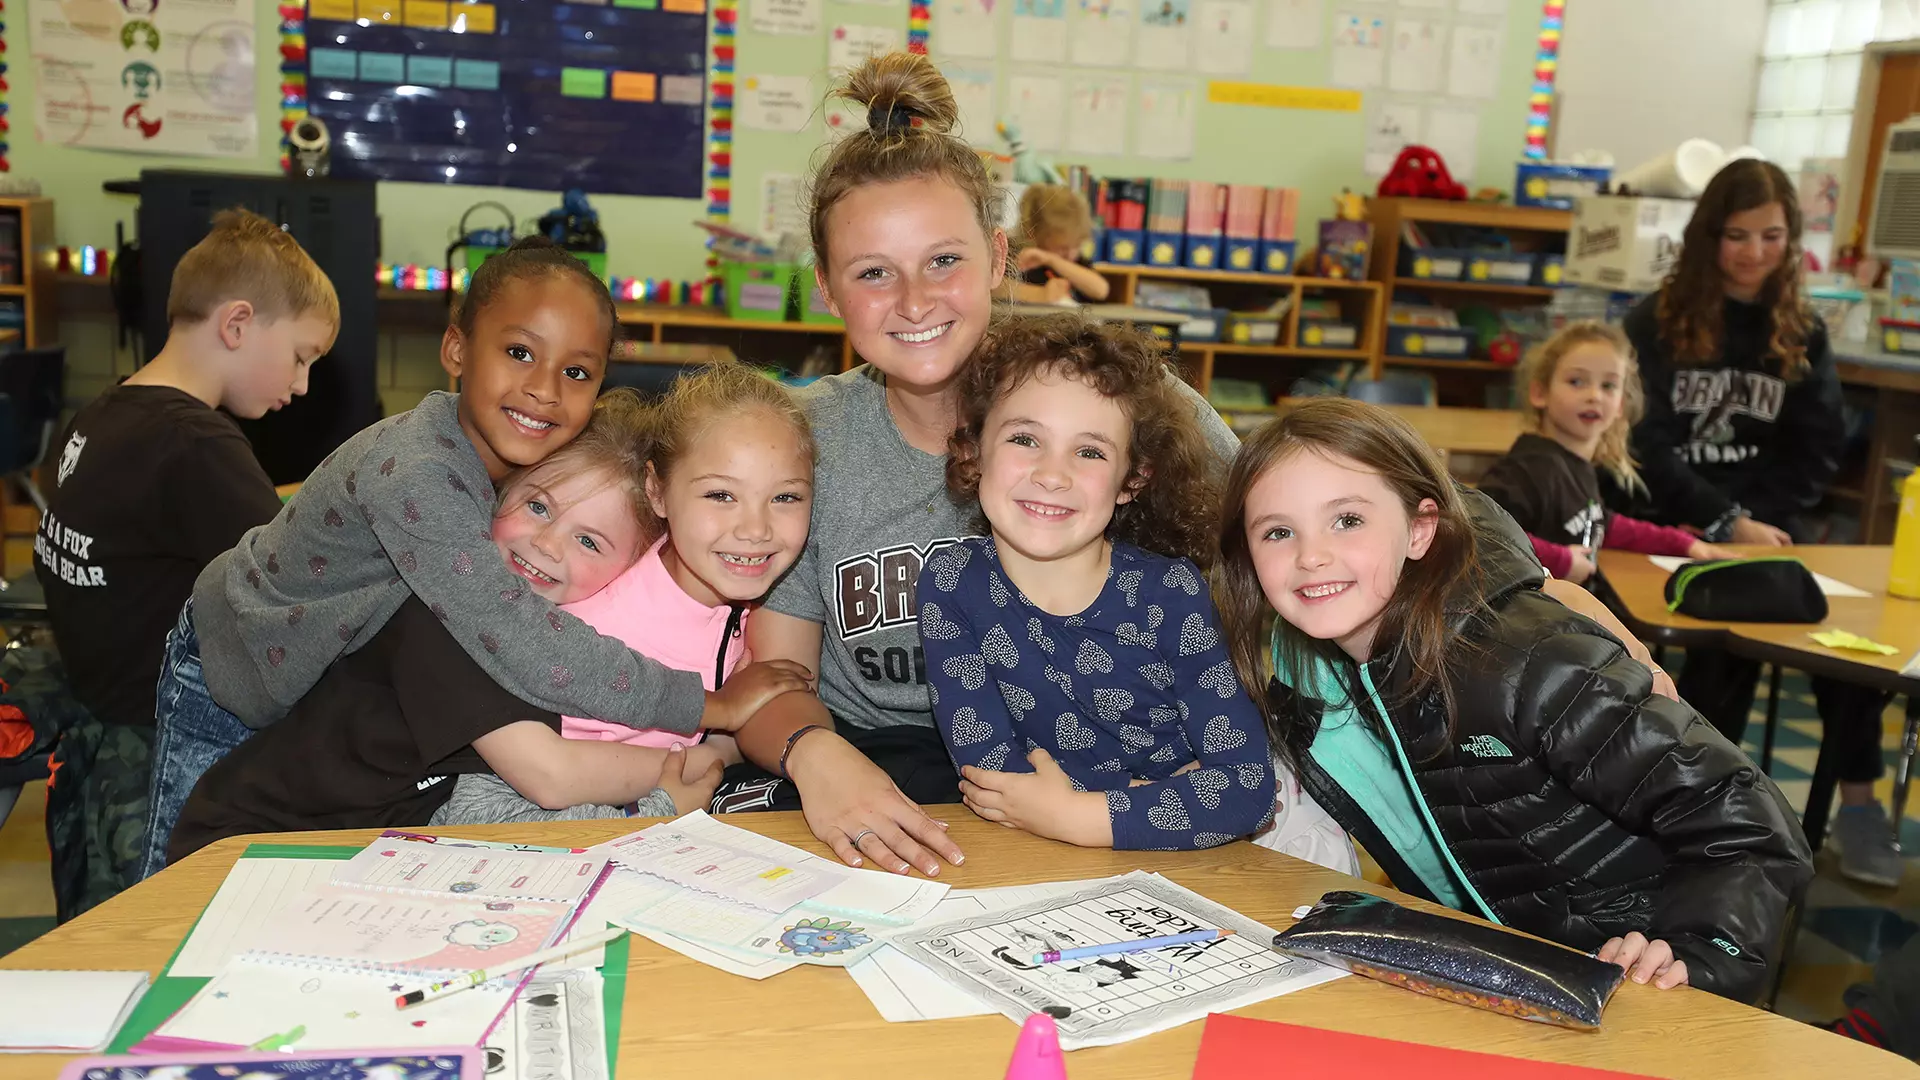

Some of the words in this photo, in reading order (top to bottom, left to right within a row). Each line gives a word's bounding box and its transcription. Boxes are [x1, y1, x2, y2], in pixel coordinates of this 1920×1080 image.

[62, 527, 93, 560] FOX
[60, 556, 107, 586] BEAR
[833, 537, 958, 641] BR
[1459, 743, 1494, 752] NORTH
[1468, 735, 1489, 743] THE
[1473, 750, 1498, 758] FACE
[1105, 908, 1204, 963] Wting
[1135, 904, 1228, 952] Flder
